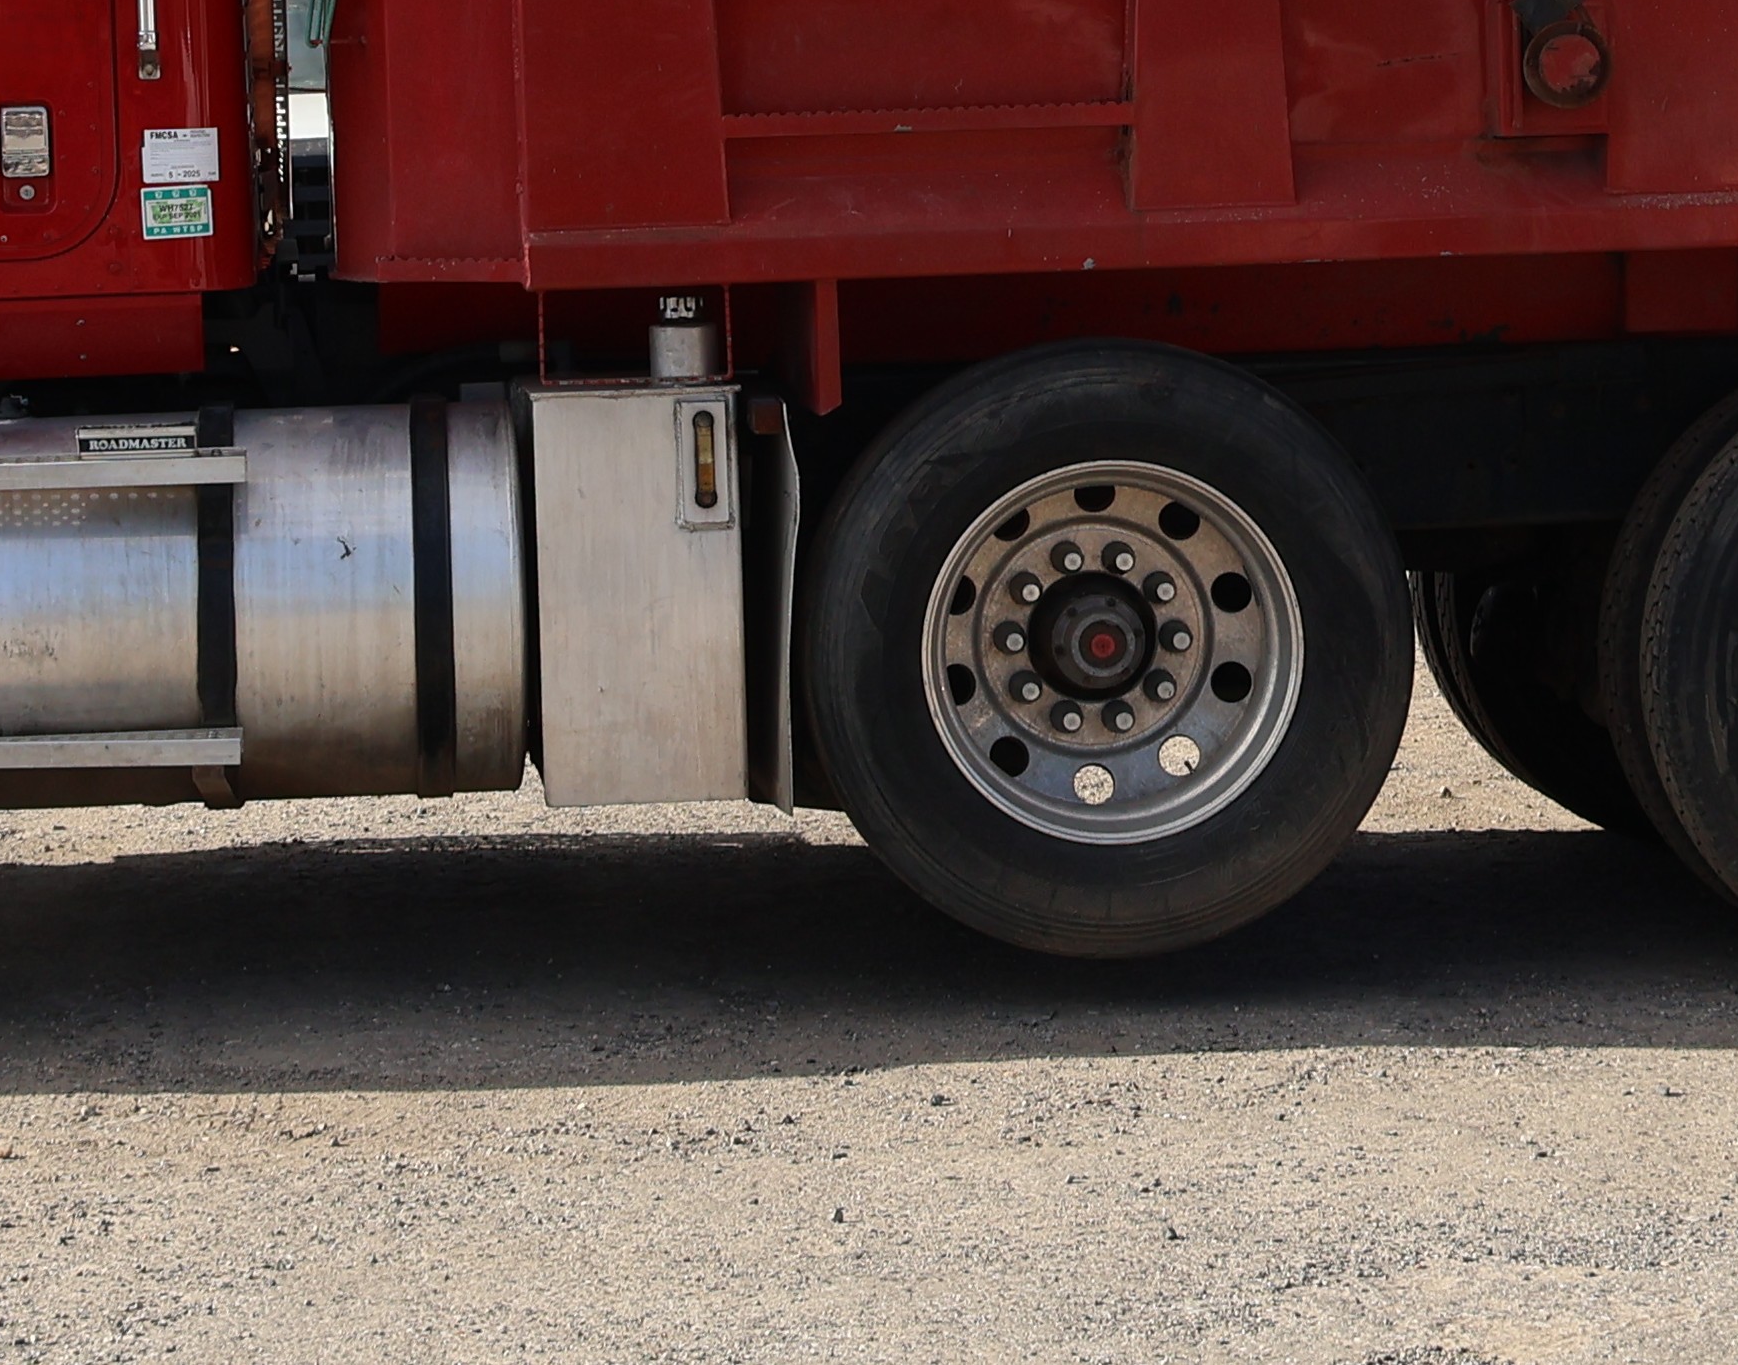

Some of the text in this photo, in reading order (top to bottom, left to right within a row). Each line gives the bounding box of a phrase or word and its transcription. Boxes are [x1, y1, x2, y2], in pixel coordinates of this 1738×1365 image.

[150, 131, 179, 140] FMCSA
[183, 169, 201, 178] 2025
[153, 227, 167, 235] PA
[89, 437, 187, 451] ROADMASTER
